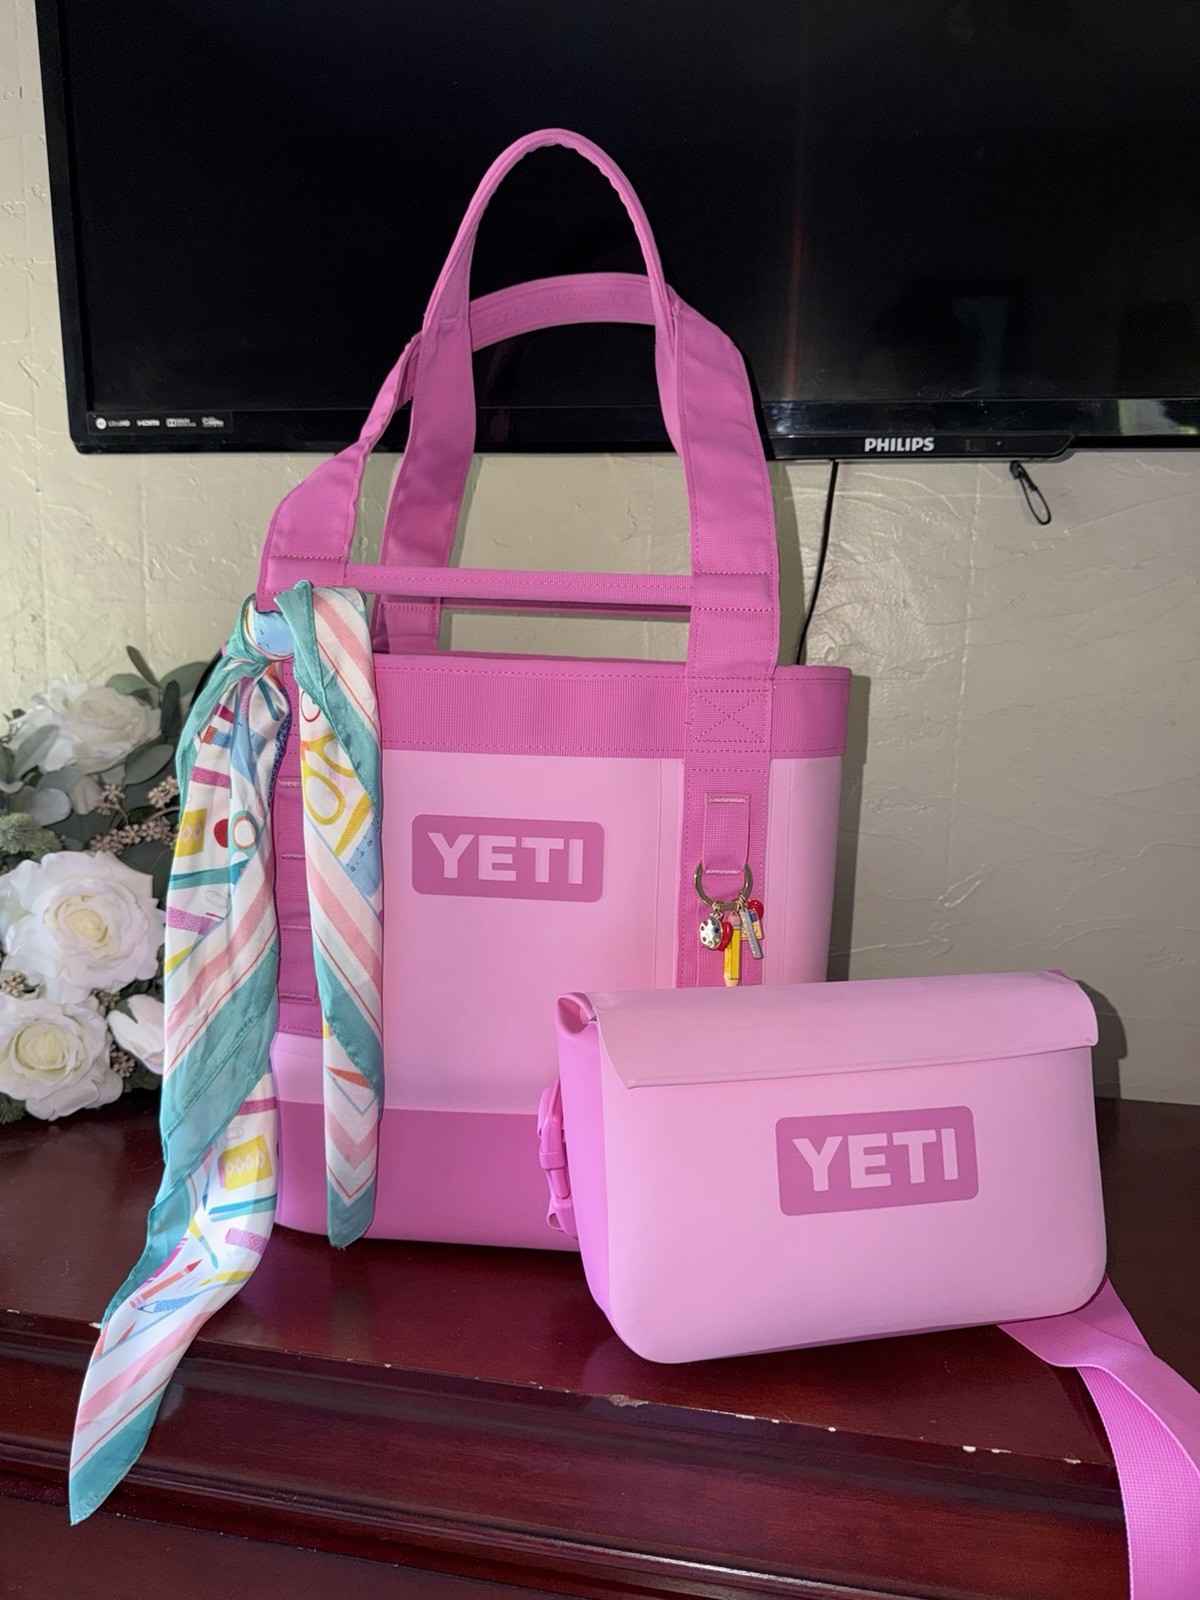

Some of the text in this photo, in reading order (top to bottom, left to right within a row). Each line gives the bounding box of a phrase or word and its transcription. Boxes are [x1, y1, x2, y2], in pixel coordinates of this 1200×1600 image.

[864, 437, 935, 452] PHILIPS
[427, 832, 584, 885] YETI
[791, 1128, 959, 1192] YETI
